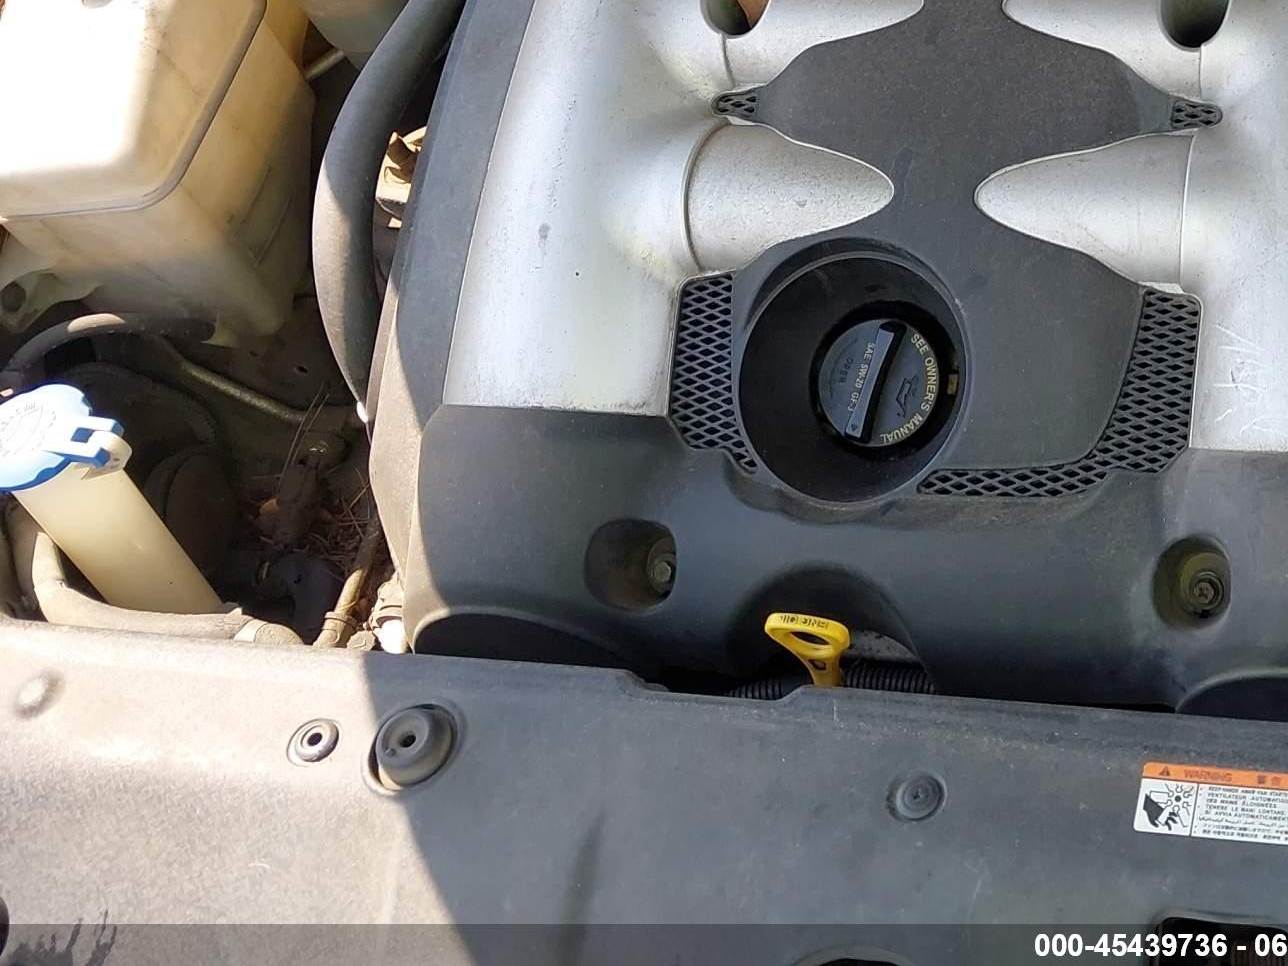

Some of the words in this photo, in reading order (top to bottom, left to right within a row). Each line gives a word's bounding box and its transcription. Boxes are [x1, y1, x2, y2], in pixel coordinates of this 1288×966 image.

[864, 342, 875, 360] SAE
[910, 333, 929, 355] SEE
[921, 356, 937, 412] OWNER'S
[880, 412, 924, 443] MANUAL
[1184, 769, 1233, 782] WARNING
